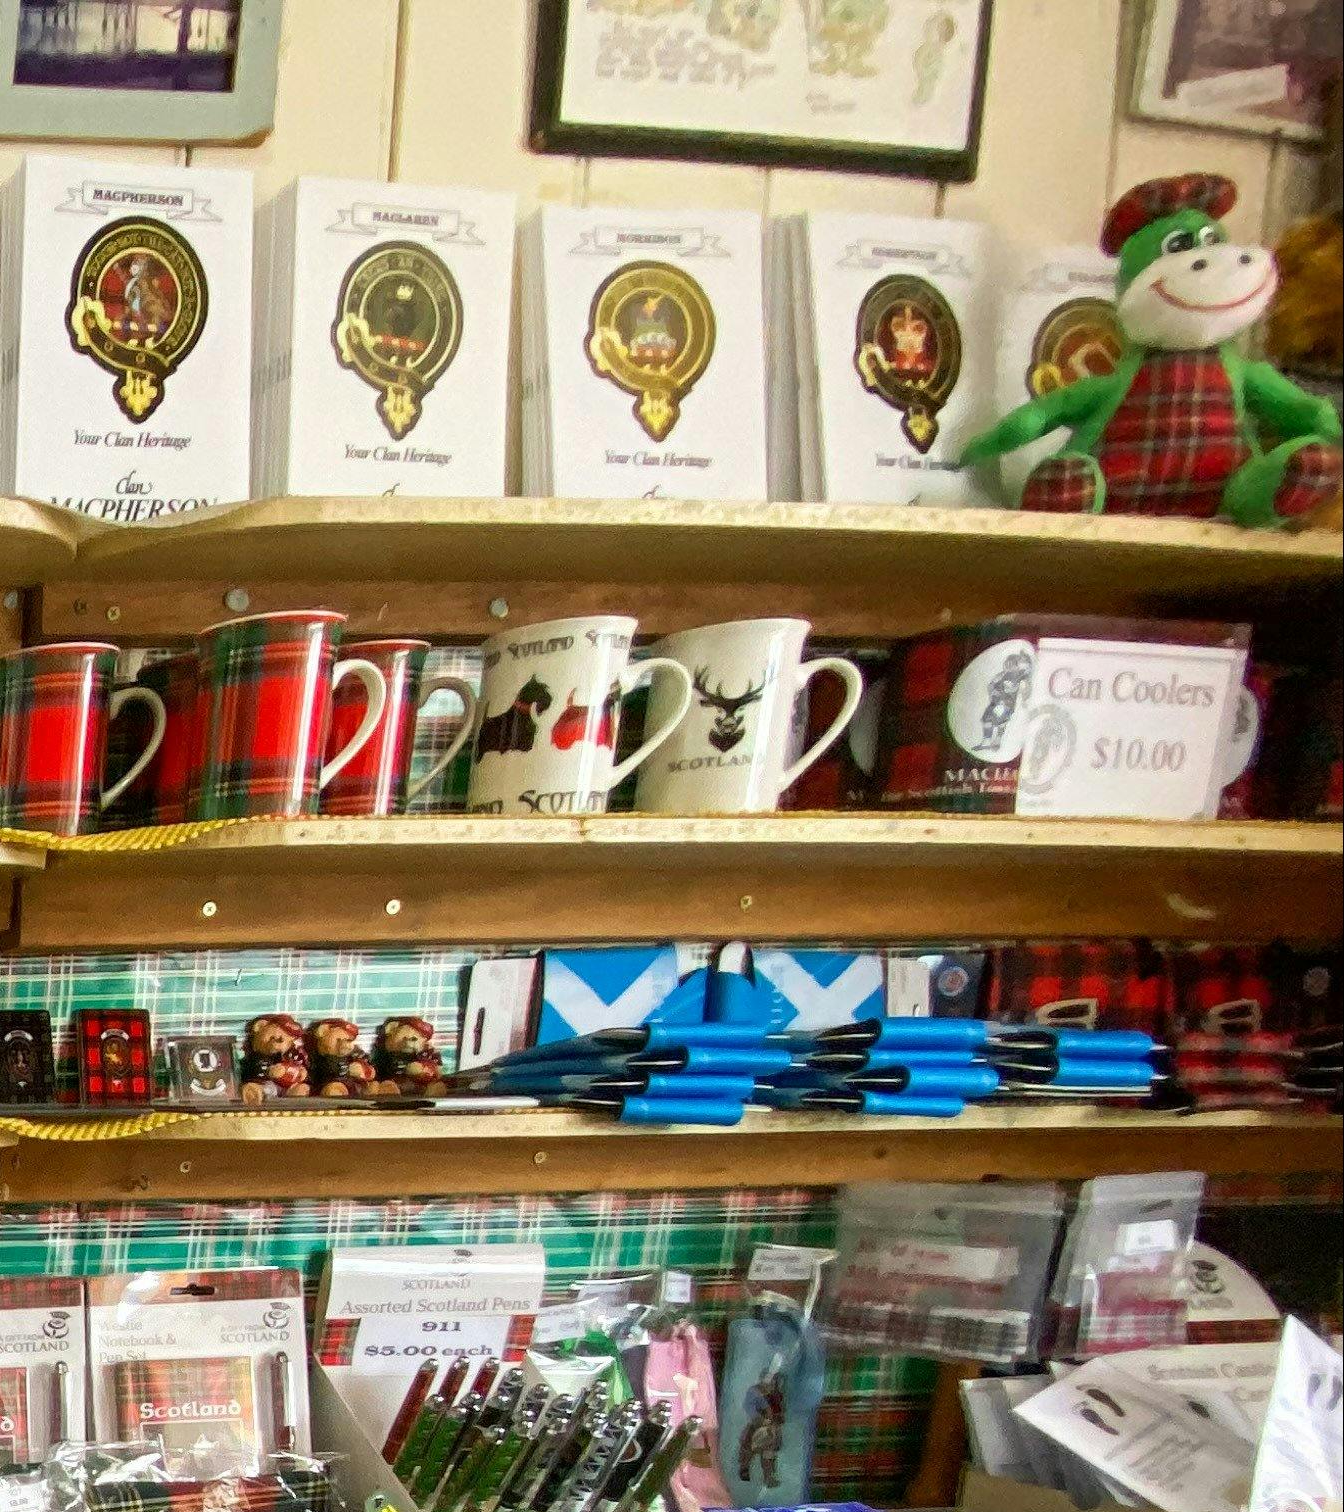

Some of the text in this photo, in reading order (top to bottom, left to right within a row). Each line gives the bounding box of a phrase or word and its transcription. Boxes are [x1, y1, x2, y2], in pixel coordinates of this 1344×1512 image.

[93, 188, 184, 208] MACPHERSON
[72, 430, 191, 450] Your Clan Heritage
[344, 444, 452, 466] Your Clan Heritage
[116, 470, 153, 495] Clan
[1047, 668, 1215, 709] Can Coolers
[667, 754, 755, 773] SCOTLAN
[1089, 735, 1187, 773] $10.00
[339, 1296, 531, 1315] Assorted Scotland Pens
[219, 1328, 291, 1344] SCOTLAND
[421, 1319, 462, 1334] 911
[364, 1343, 438, 1360] $5.00
[140, 1398, 243, 1420] Scotland
